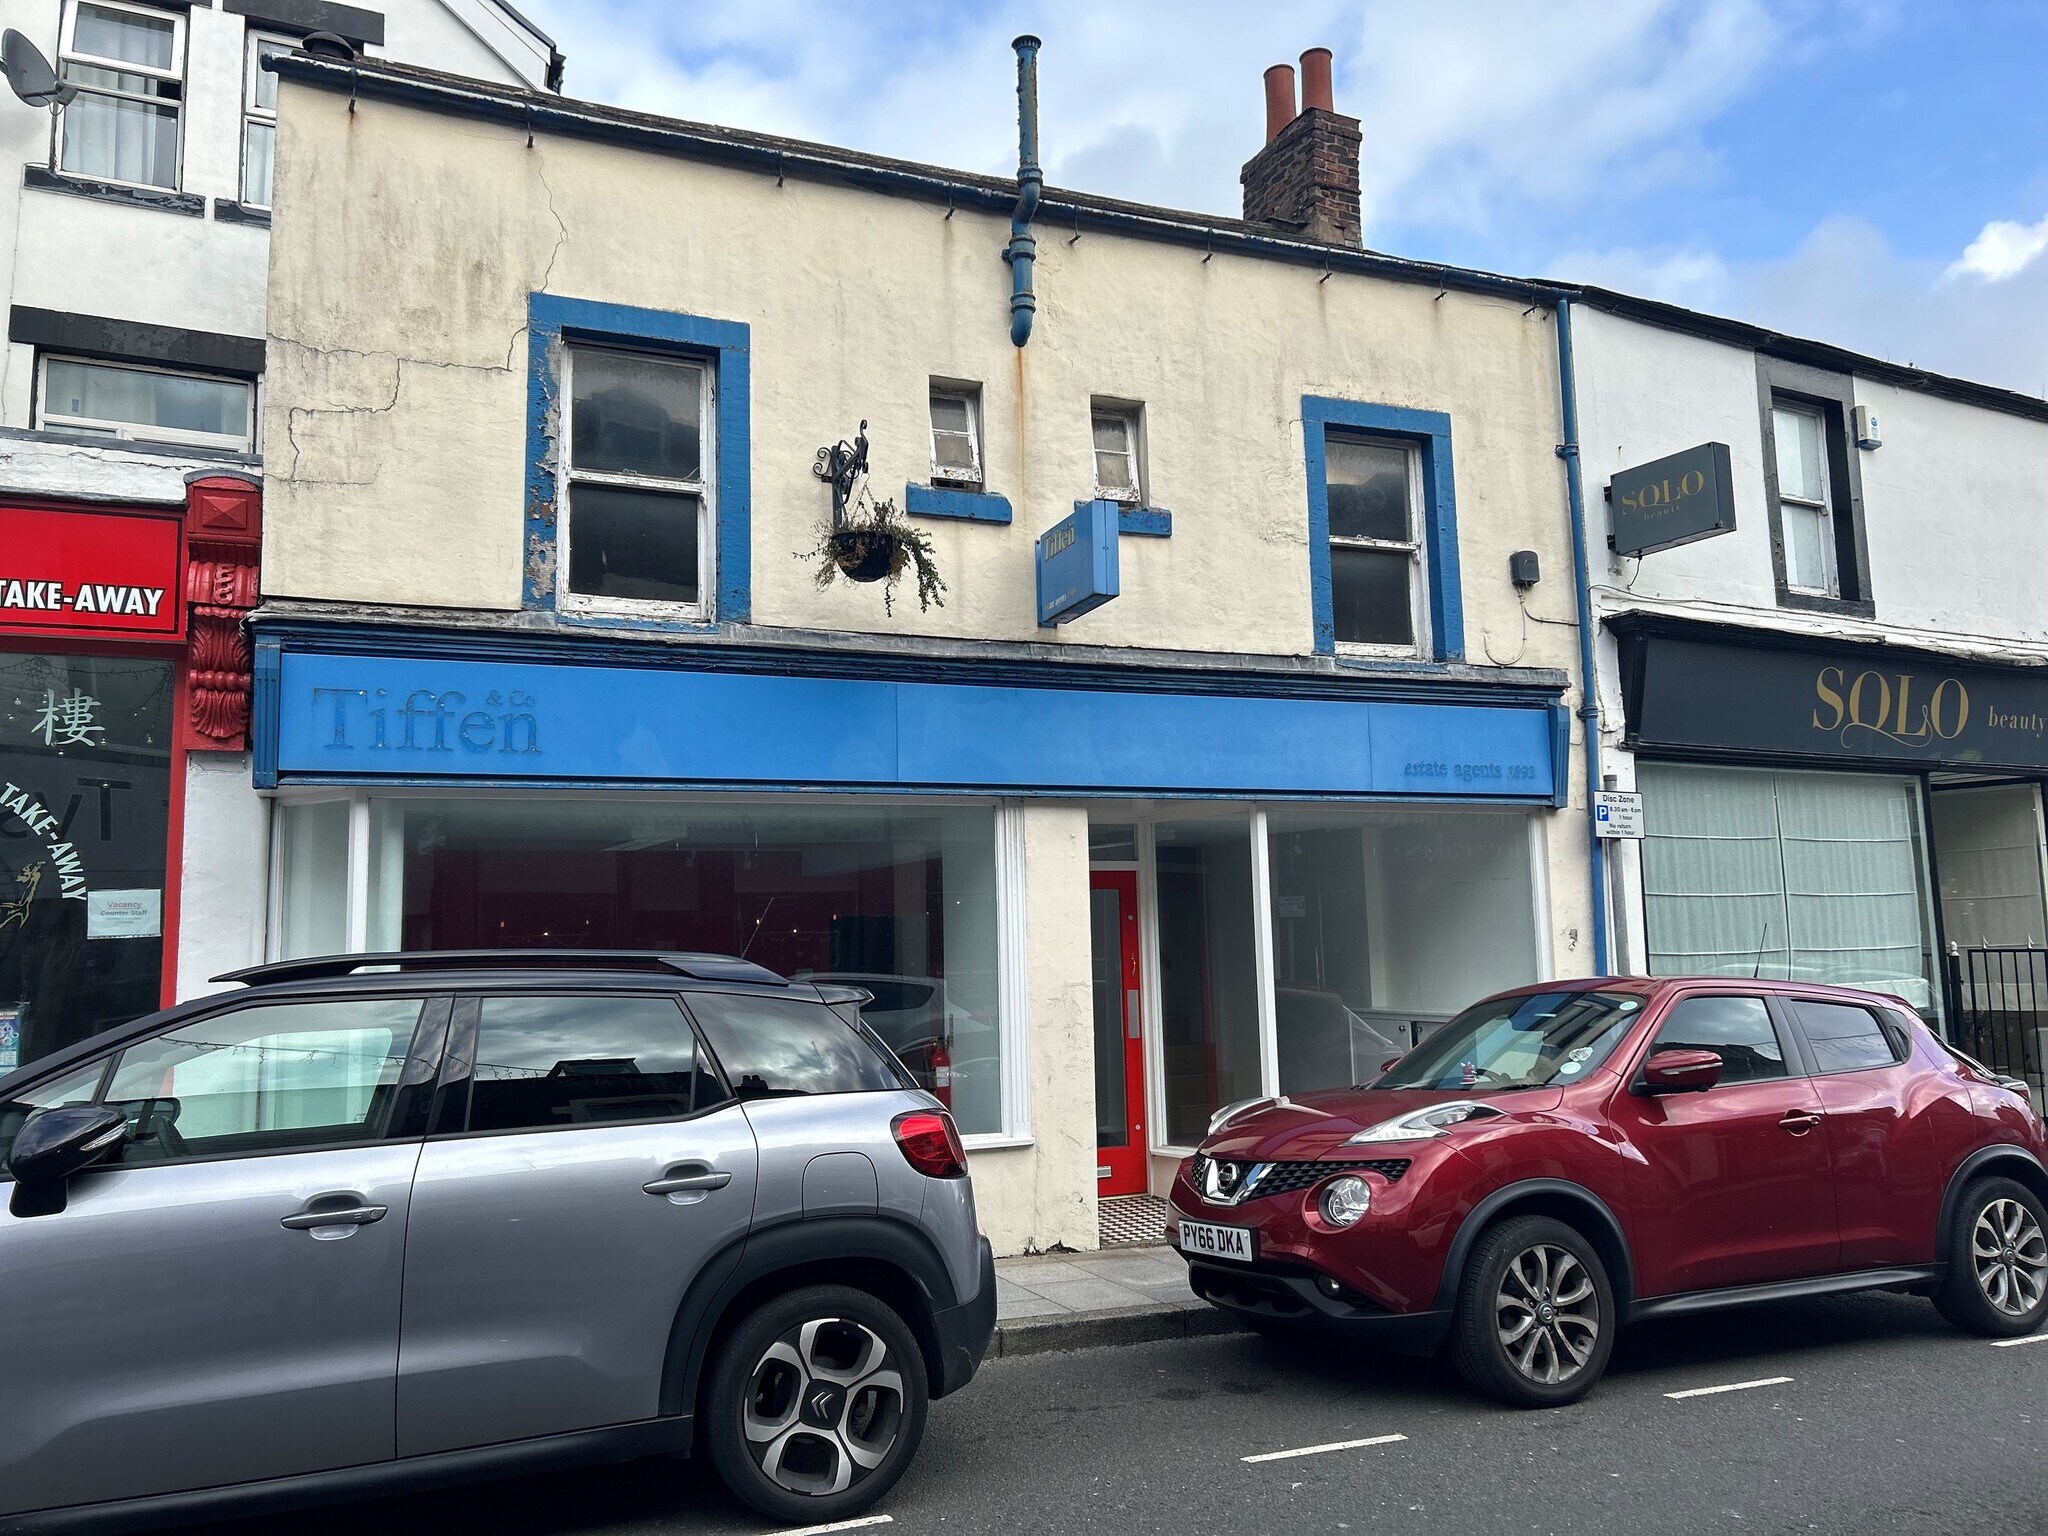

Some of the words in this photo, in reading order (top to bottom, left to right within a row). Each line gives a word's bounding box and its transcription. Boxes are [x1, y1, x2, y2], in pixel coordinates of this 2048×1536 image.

[1622, 470, 1705, 515] SOLO
[1043, 527, 1075, 560] Tiffen
[31, 688, 105, 747] 樓
[311, 687, 542, 753] Tiffen
[1812, 666, 1970, 748] SOLO
[1988, 705, 2047, 738] beauty
[1404, 761, 1448, 777] estate
[1454, 762, 1502, 782] agents
[1599, 807, 1607, 819] P
[1602, 794, 1617, 802] Disc
[1618, 795, 1635, 803] Zone
[0, 782, 87, 900] TAKE-AWAY
[107, 901, 143, 909] Vacancy
[1183, 1224, 1214, 1250] PY66
[1216, 1229, 1244, 1255] DKA
